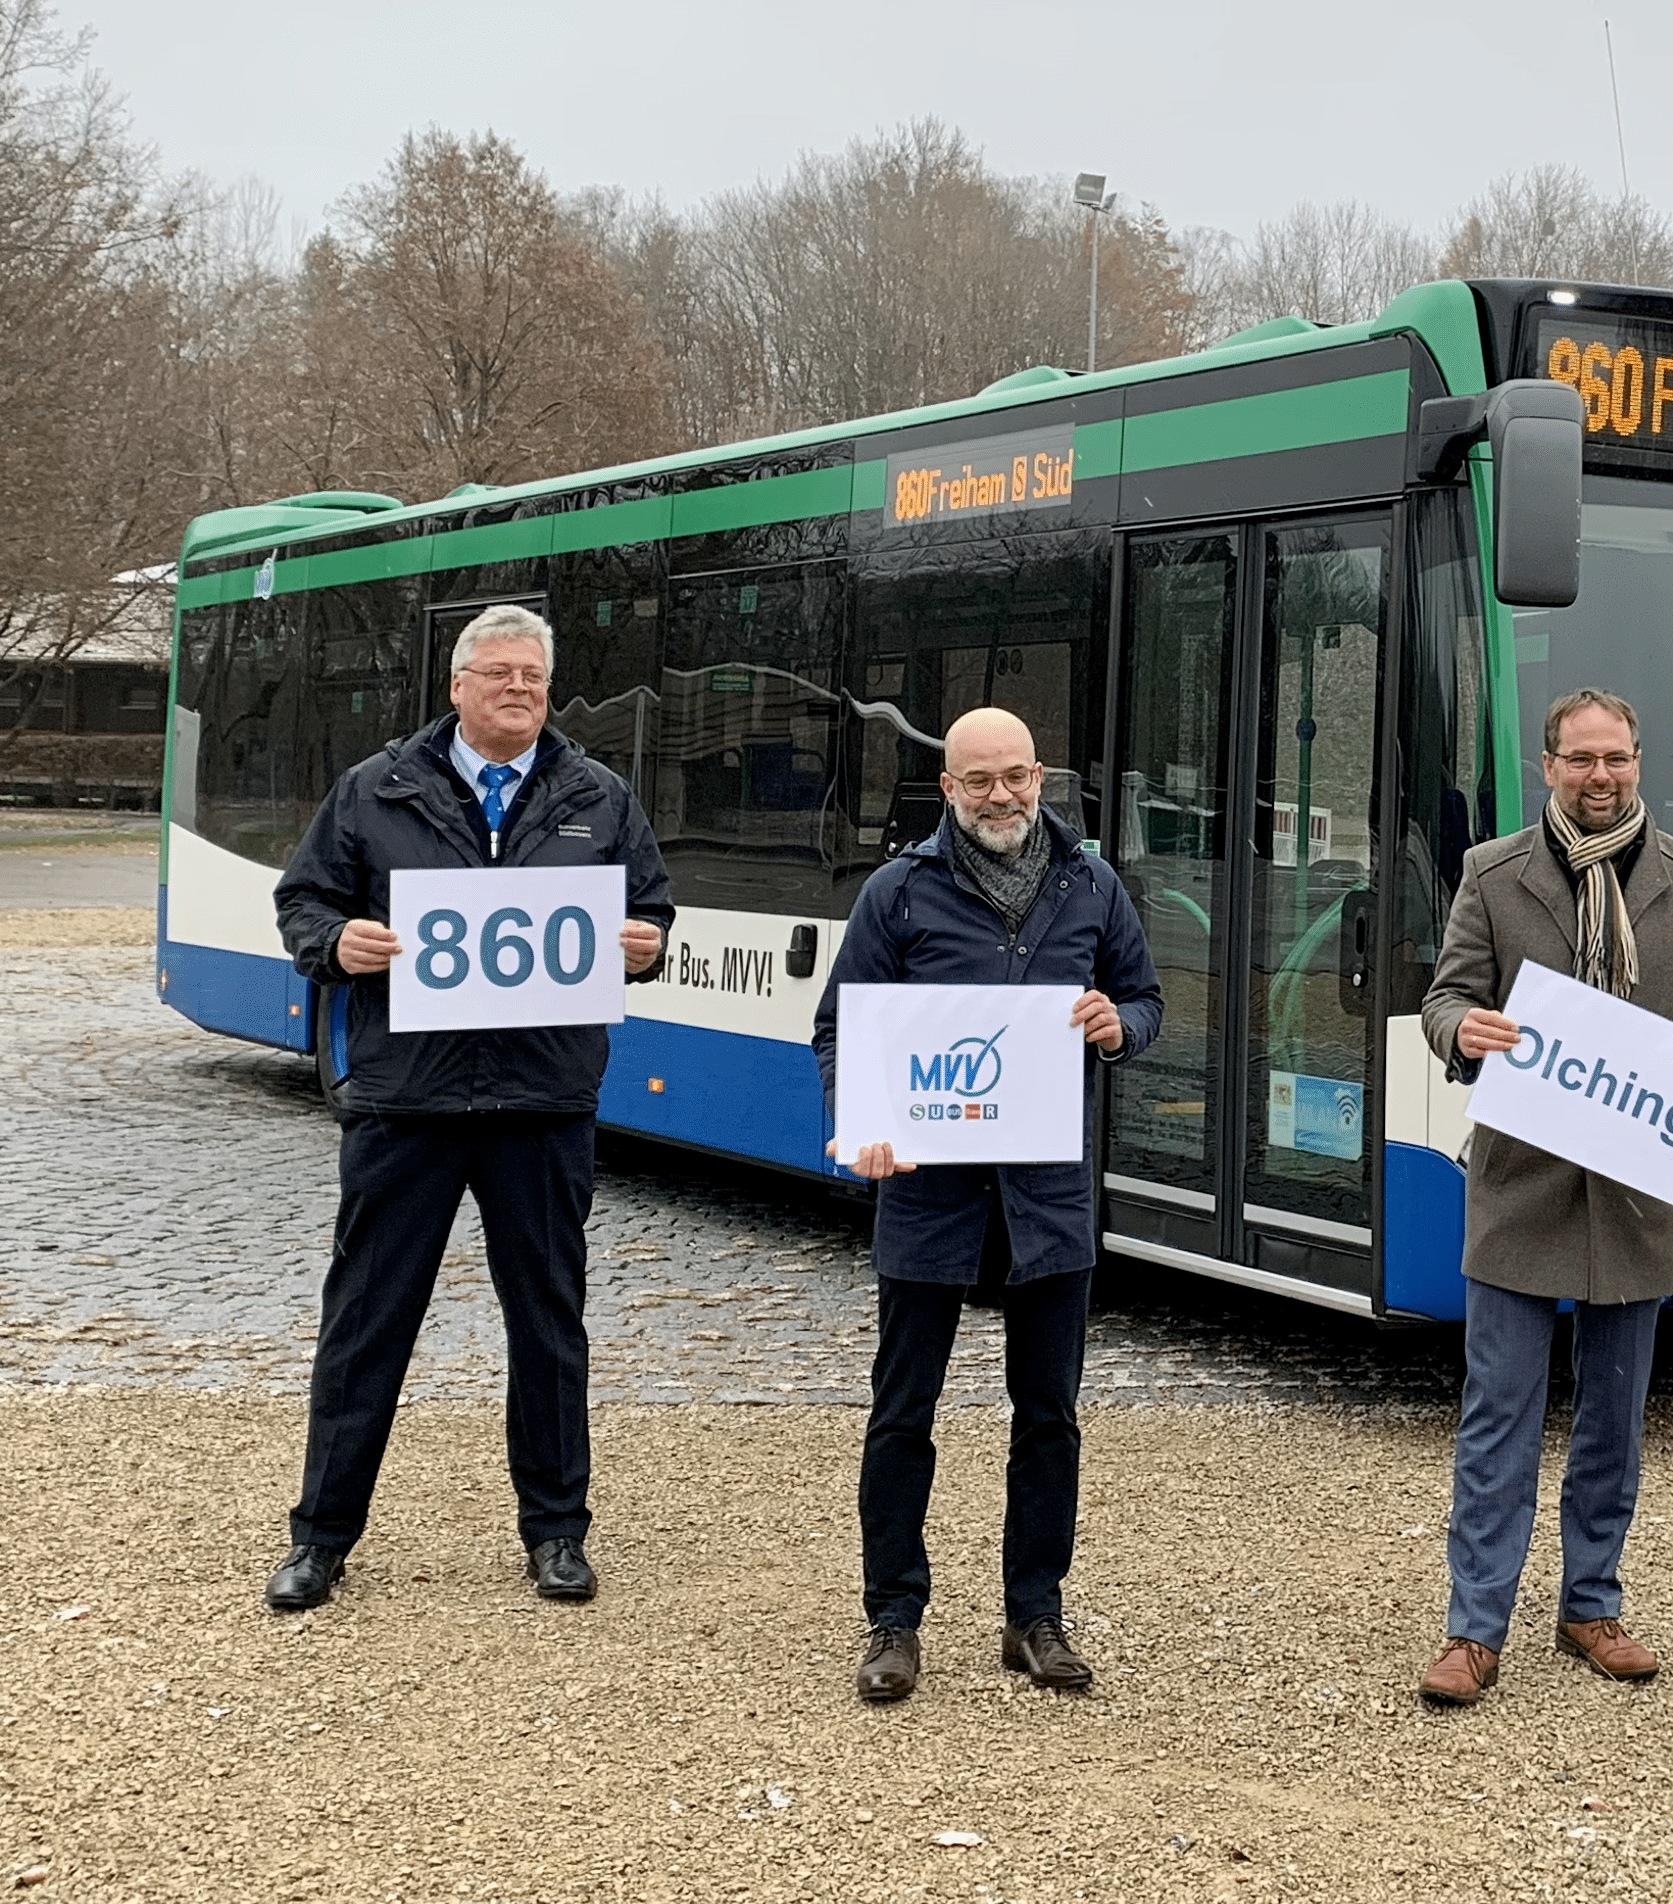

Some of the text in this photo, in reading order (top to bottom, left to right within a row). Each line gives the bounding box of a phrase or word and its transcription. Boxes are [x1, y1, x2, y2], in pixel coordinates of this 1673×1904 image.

[895, 468, 929, 520] 860
[927, 464, 1006, 512] Freiham
[1032, 448, 1074, 499] Süd
[414, 905, 596, 990] 860
[679, 942, 715, 990] Bus.
[720, 946, 773, 998] MVV!
[910, 1024, 1009, 1092] MVV
[930, 1105, 942, 1119] U
[985, 1105, 996, 1119] R
